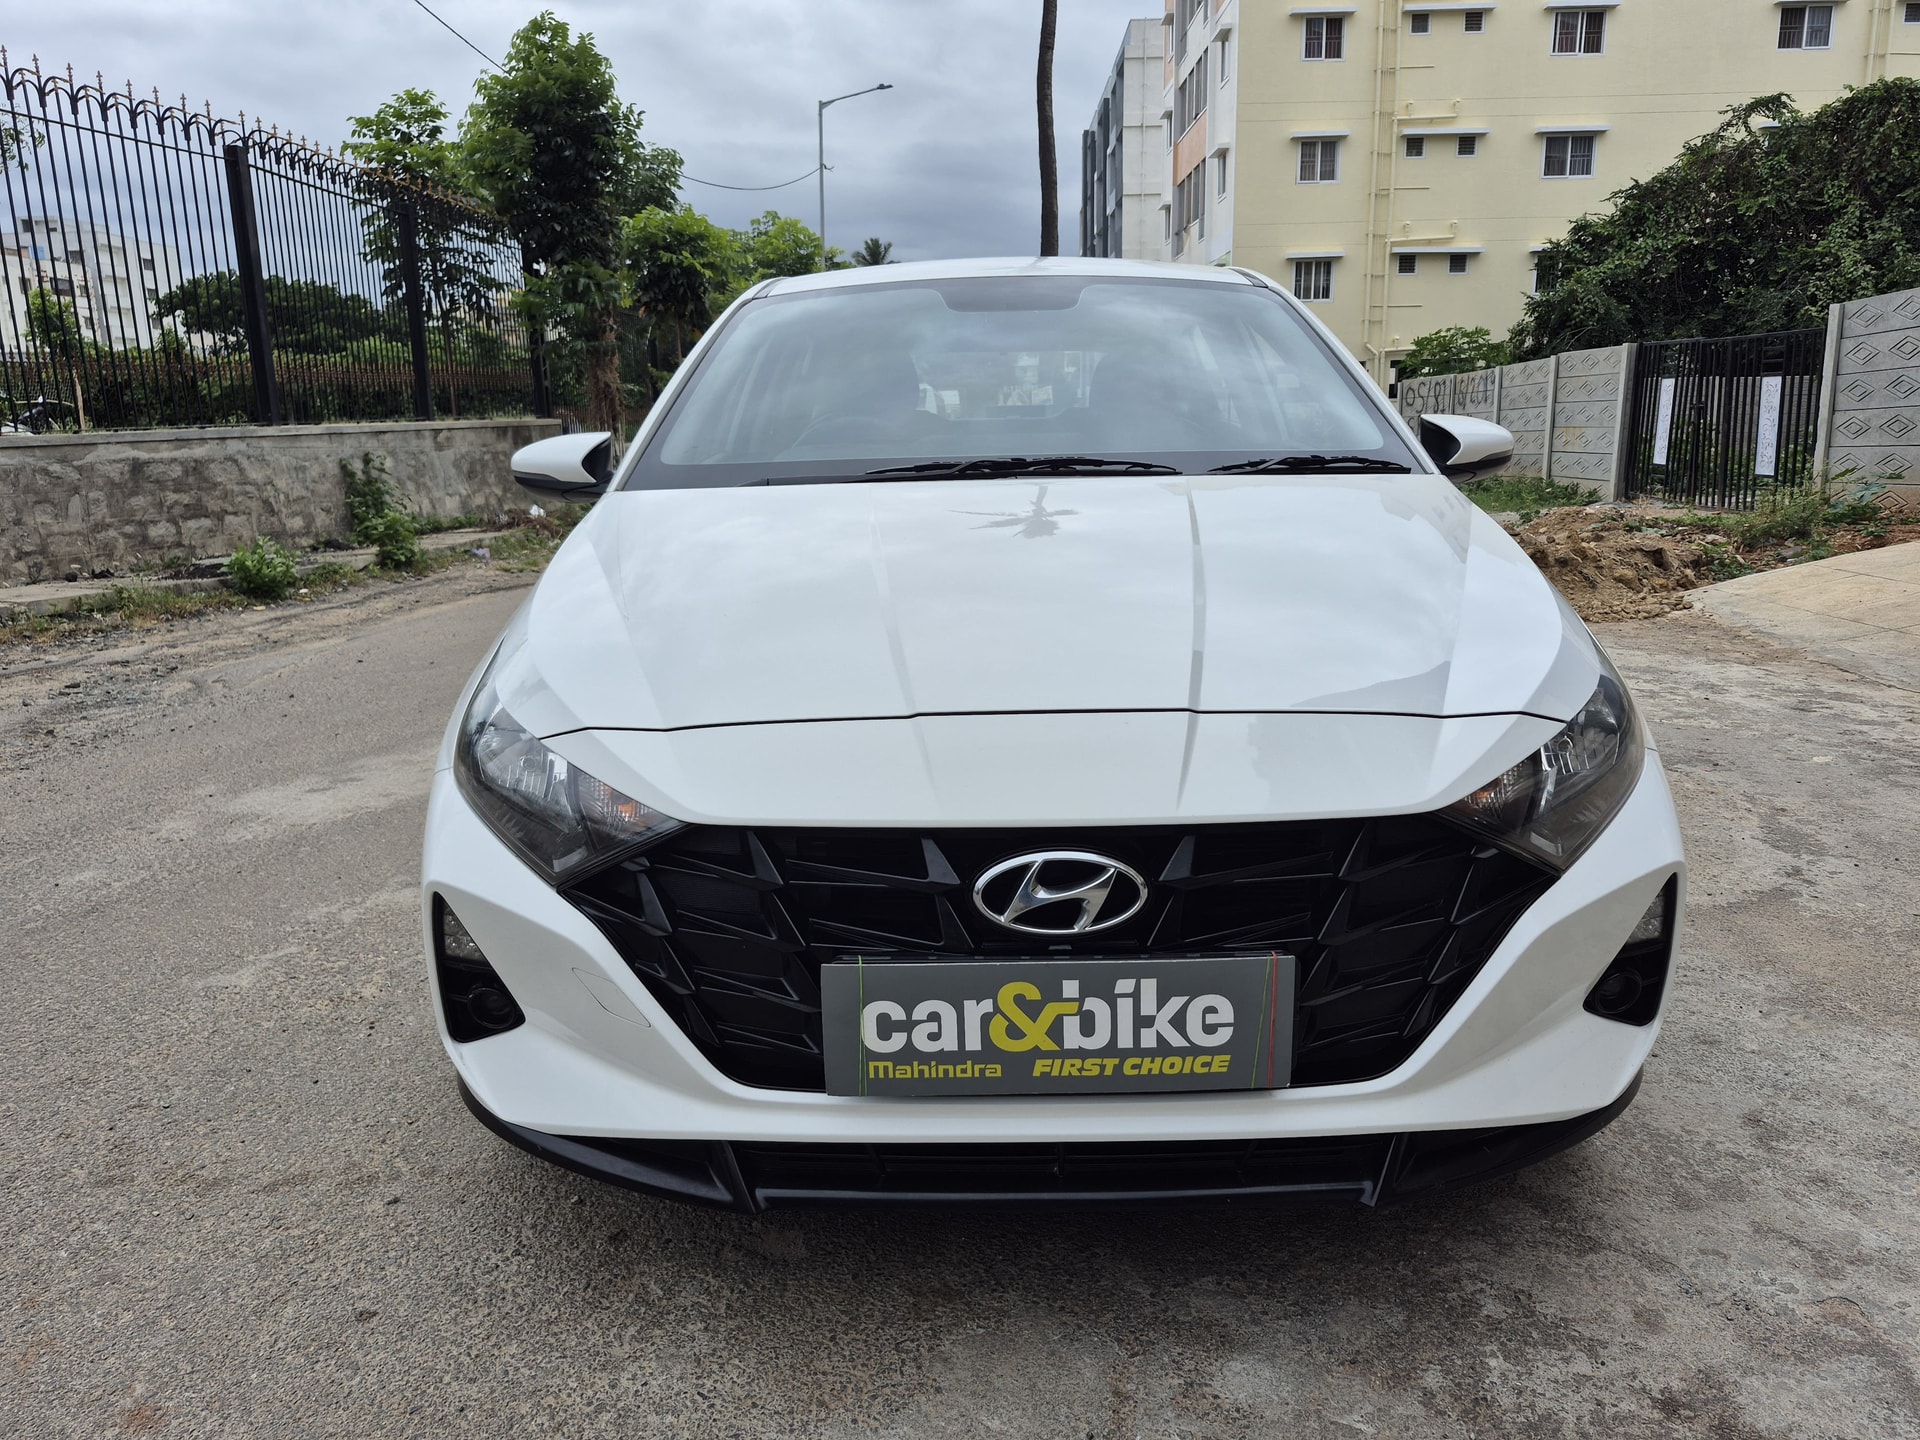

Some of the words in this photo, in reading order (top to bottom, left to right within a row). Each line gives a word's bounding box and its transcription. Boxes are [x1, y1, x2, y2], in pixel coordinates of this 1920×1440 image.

[861, 978, 1234, 1054] car&bike
[868, 1059, 1003, 1079] Mahindra
[1032, 1057, 1120, 1077] FIRST
[1122, 1054, 1232, 1076] CHOICE
